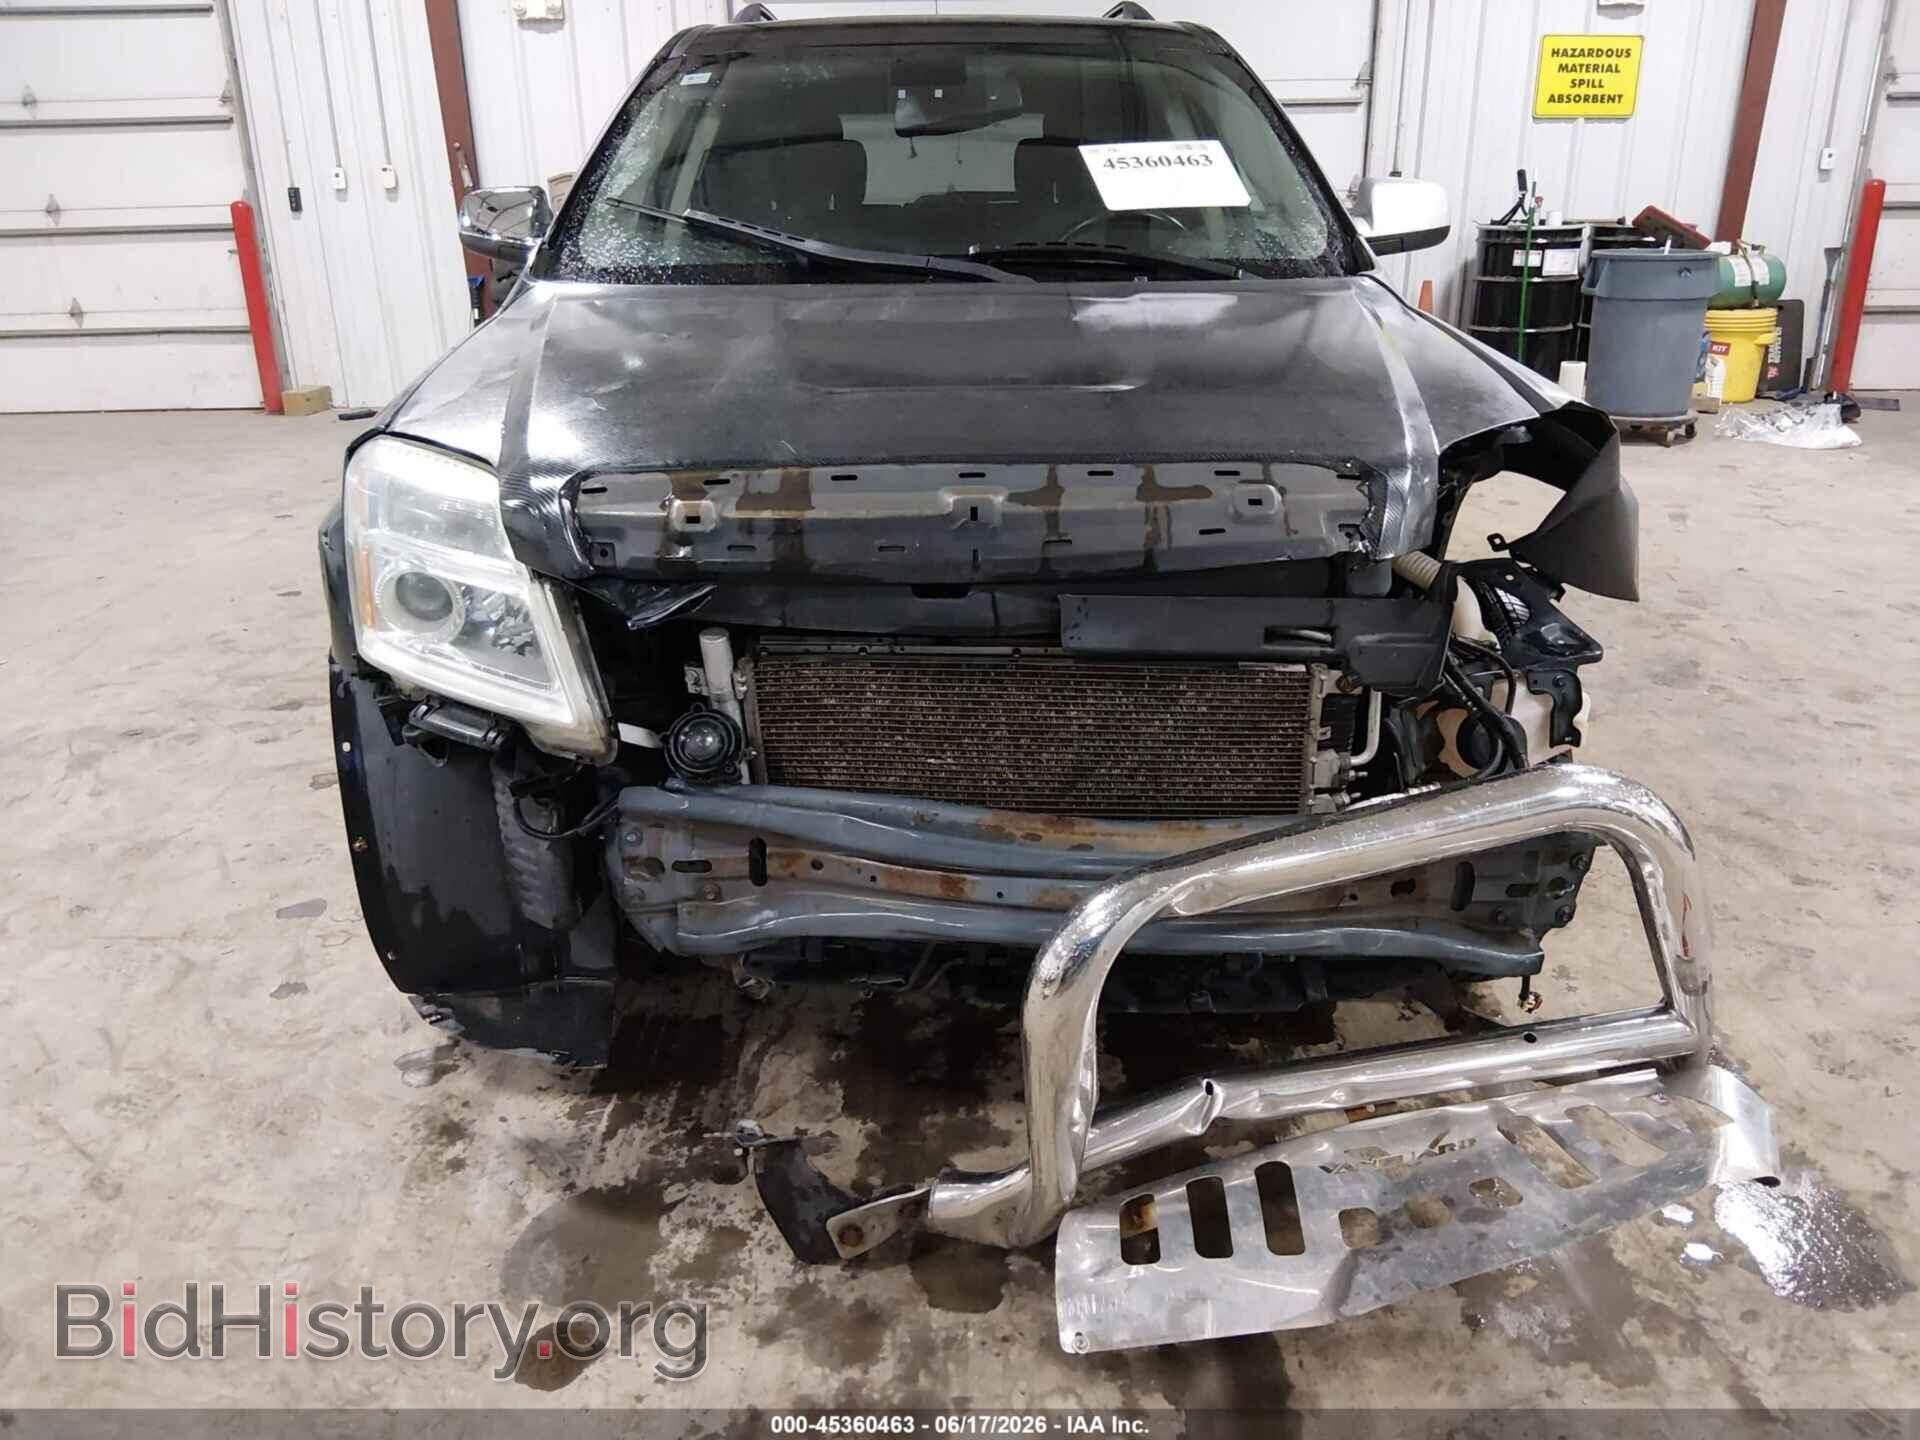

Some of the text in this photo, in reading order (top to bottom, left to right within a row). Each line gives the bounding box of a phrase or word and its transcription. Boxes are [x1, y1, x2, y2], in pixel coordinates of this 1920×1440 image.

[1551, 48, 1632, 58] HAZARDOUS
[1558, 63, 1621, 73] MATERIAL
[1569, 78, 1604, 88] SPILL
[1547, 93, 1624, 104] ABSORBENT
[1103, 154, 1213, 169] 45360463
